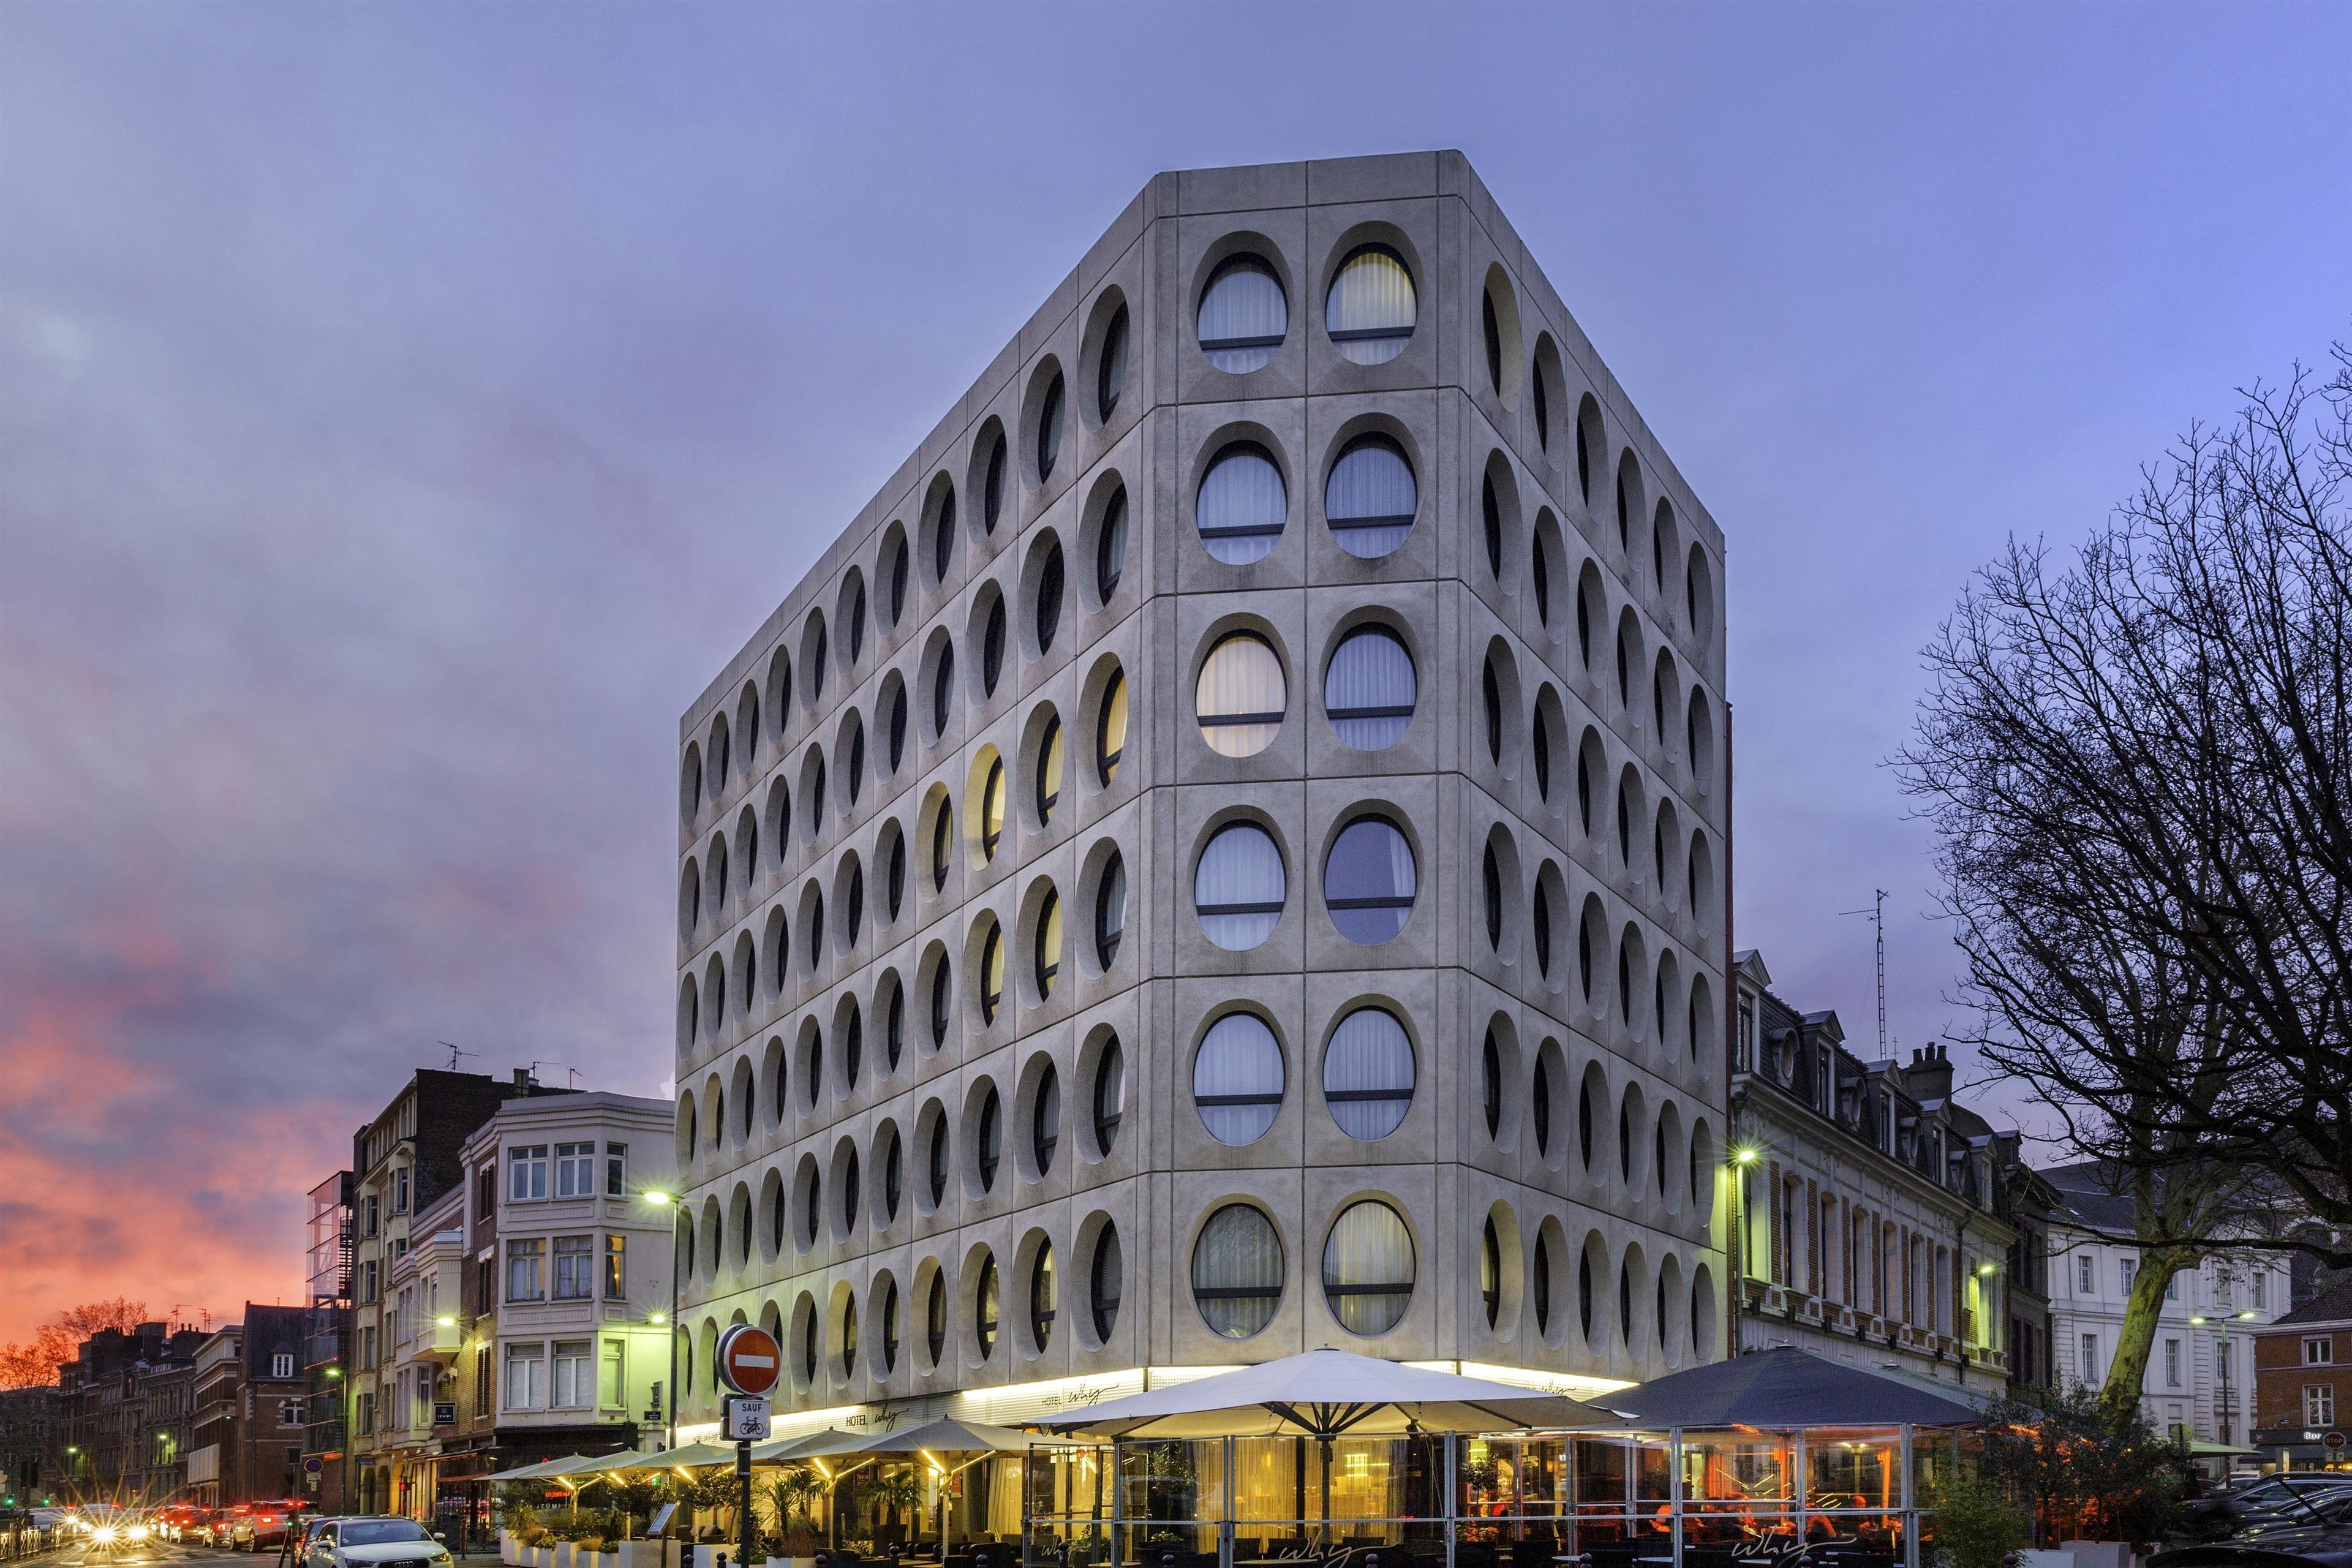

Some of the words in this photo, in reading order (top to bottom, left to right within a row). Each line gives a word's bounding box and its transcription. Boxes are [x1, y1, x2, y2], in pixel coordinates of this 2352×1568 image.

[1041, 1396, 1062, 1406] HOTEL
[742, 1403, 762, 1412] SAUF
[846, 1415, 868, 1427] HOTEL
[875, 1402, 910, 1433] why
